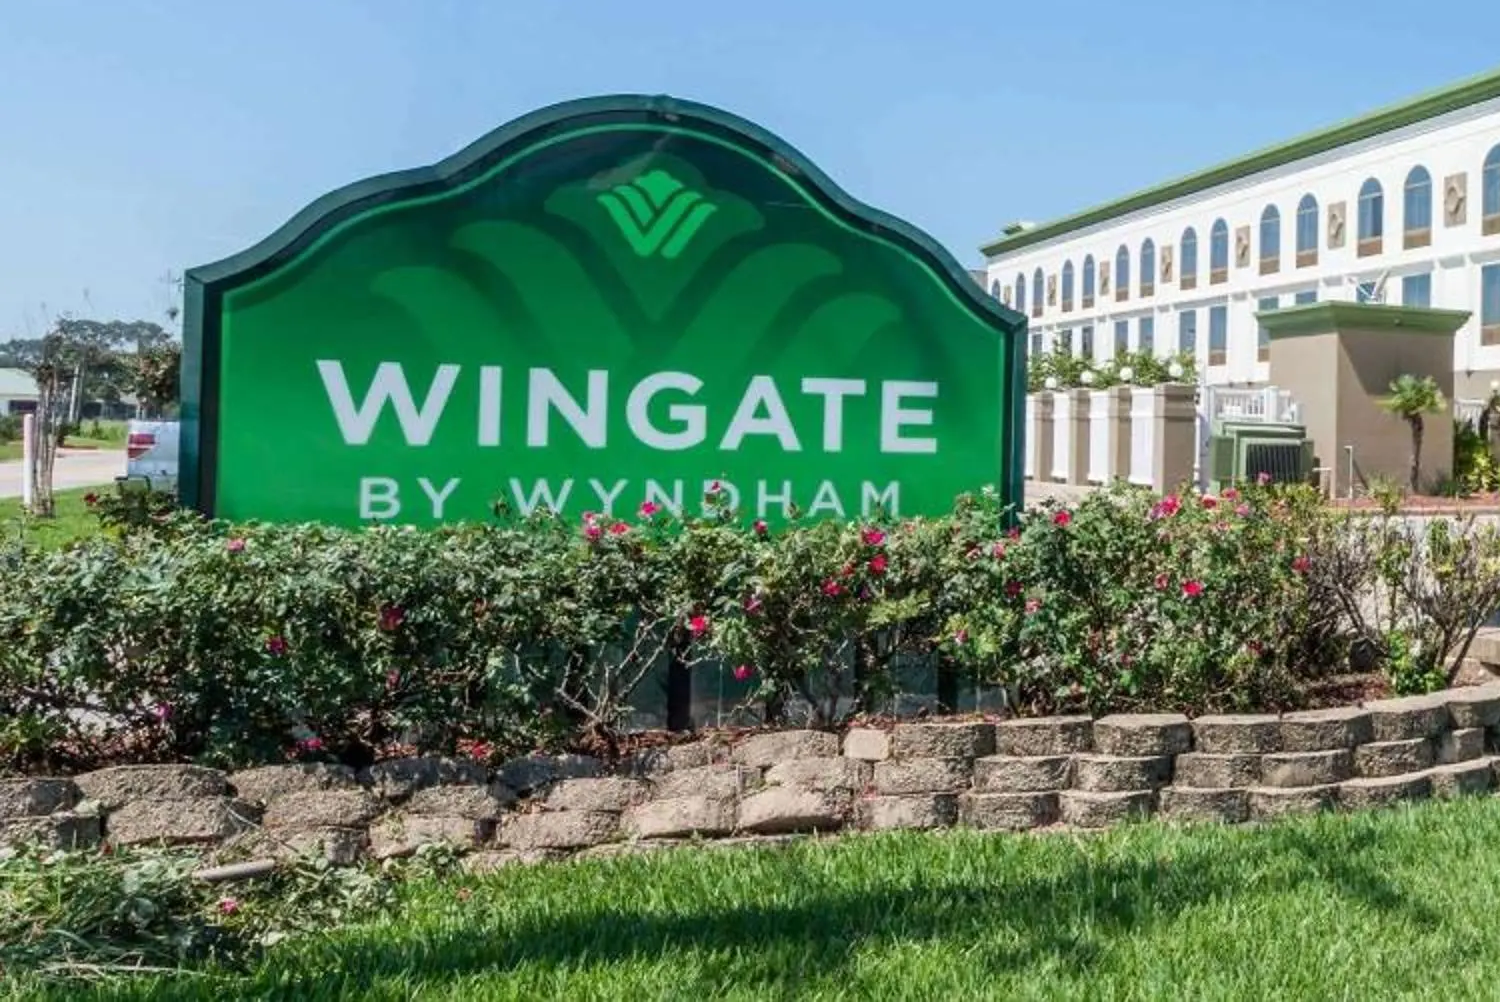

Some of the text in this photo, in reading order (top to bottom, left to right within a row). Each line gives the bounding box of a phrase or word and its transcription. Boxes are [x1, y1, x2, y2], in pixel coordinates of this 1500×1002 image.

[315, 359, 939, 453] WINGATE
[358, 477, 902, 519] BY WYNDHAM
